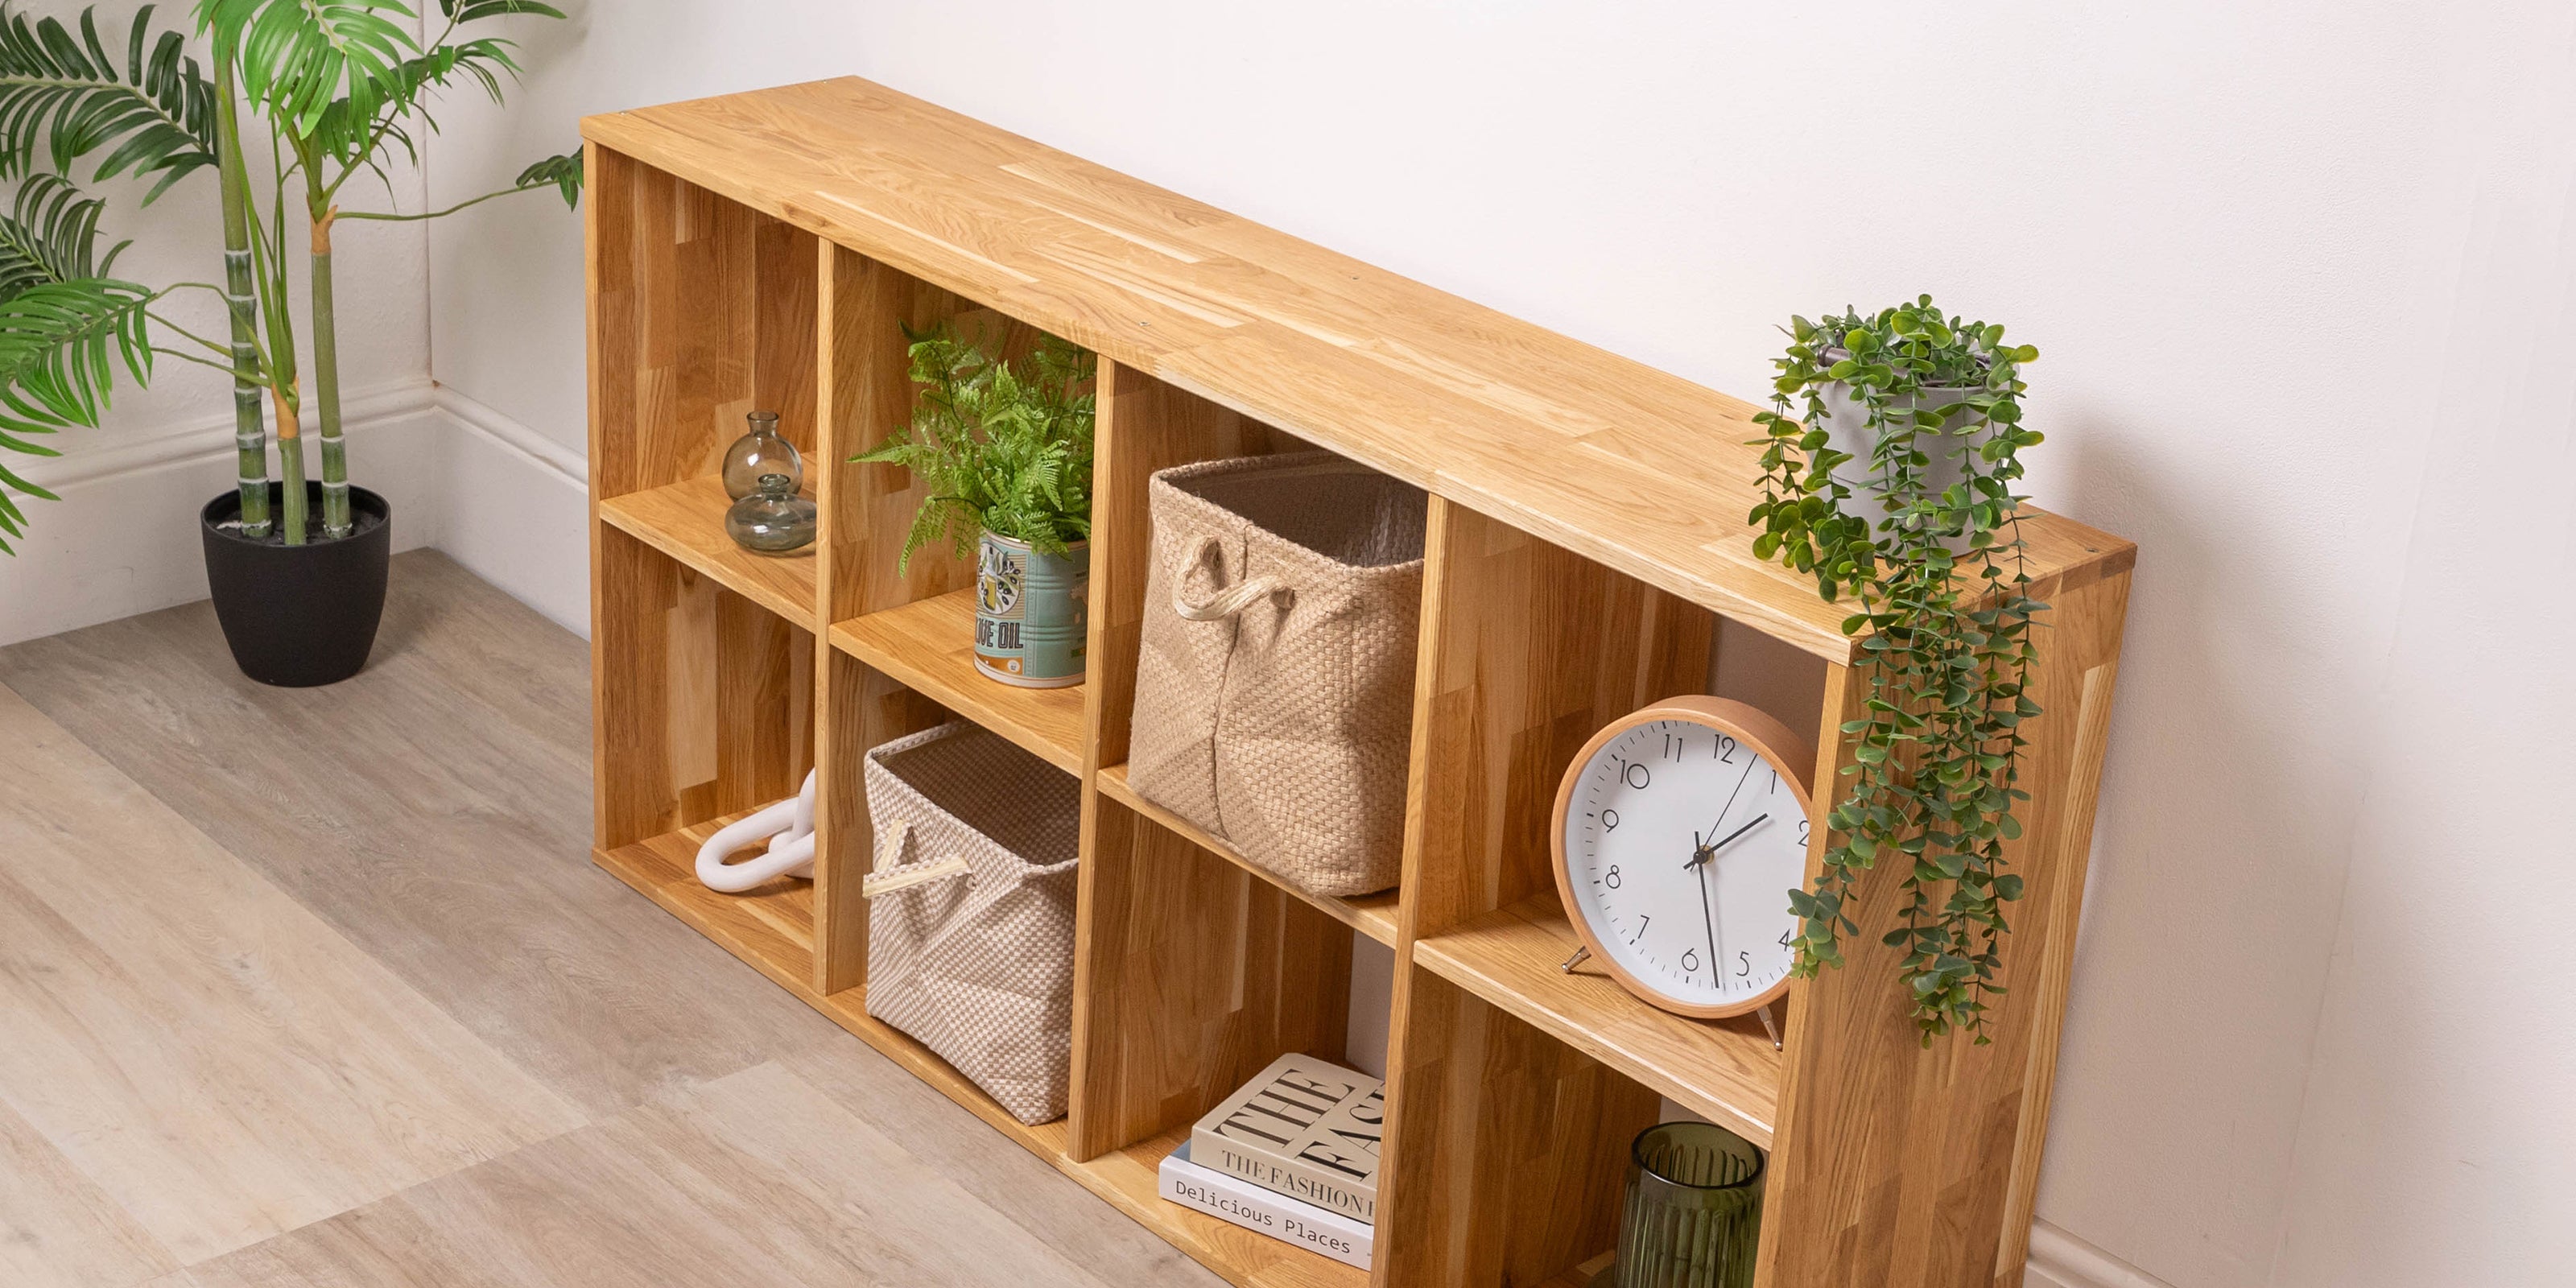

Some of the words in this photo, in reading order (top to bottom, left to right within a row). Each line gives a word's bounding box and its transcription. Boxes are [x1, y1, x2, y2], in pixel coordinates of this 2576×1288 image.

[998, 621, 1024, 649] OIL
[1664, 733, 1683, 763] 11
[1714, 733, 1736, 765] 12
[1619, 759, 1650, 790] 10
[1770, 769, 1777, 795] 1
[1601, 808, 1620, 834] 9
[1798, 819, 1809, 848] 2
[1605, 865, 1621, 890] 8
[1637, 914, 1650, 940] 7
[1777, 928, 1791, 952] 4
[1681, 947, 1699, 972] 6
[1736, 951, 1750, 977] 5
[1212, 1068, 1356, 1149] THE
[1294, 1081, 1385, 1182] FAS
[1221, 1150, 1266, 1181] THE
[1269, 1166, 1364, 1215] FASHION
[1175, 1180, 1273, 1227] Delicious
[1285, 1219, 1351, 1254] Places
